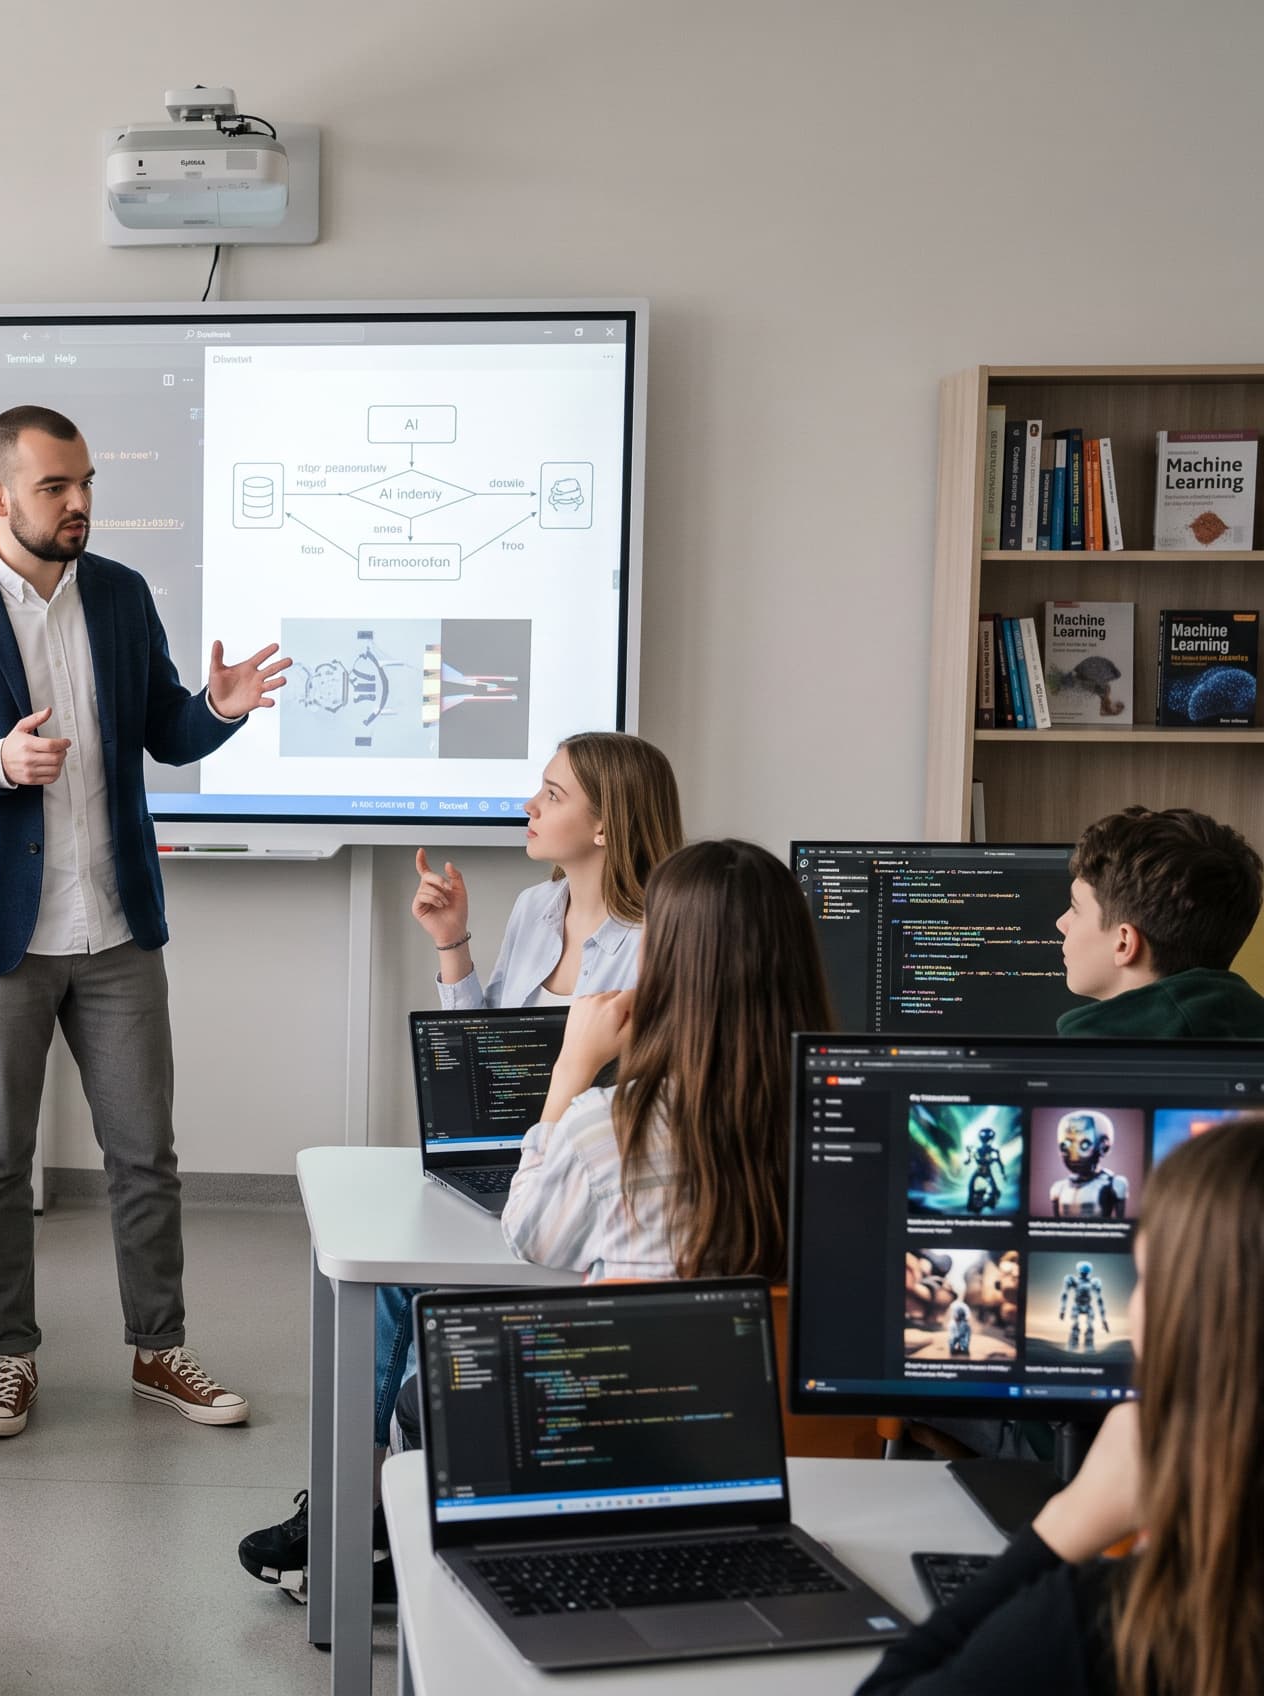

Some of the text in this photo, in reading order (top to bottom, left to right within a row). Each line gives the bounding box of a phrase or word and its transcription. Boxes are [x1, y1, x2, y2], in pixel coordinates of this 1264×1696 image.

[7, 353, 44, 363] Terminal
[54, 353, 77, 365] Help
[404, 418, 418, 430] AI
[1166, 457, 1243, 473] Machine
[1165, 474, 1245, 493] Learning
[379, 488, 392, 499] AI
[1053, 614, 1105, 626] Machine
[1053, 627, 1106, 640] Learning
[1171, 623, 1228, 638] Machine
[1171, 638, 1230, 655] Learning
